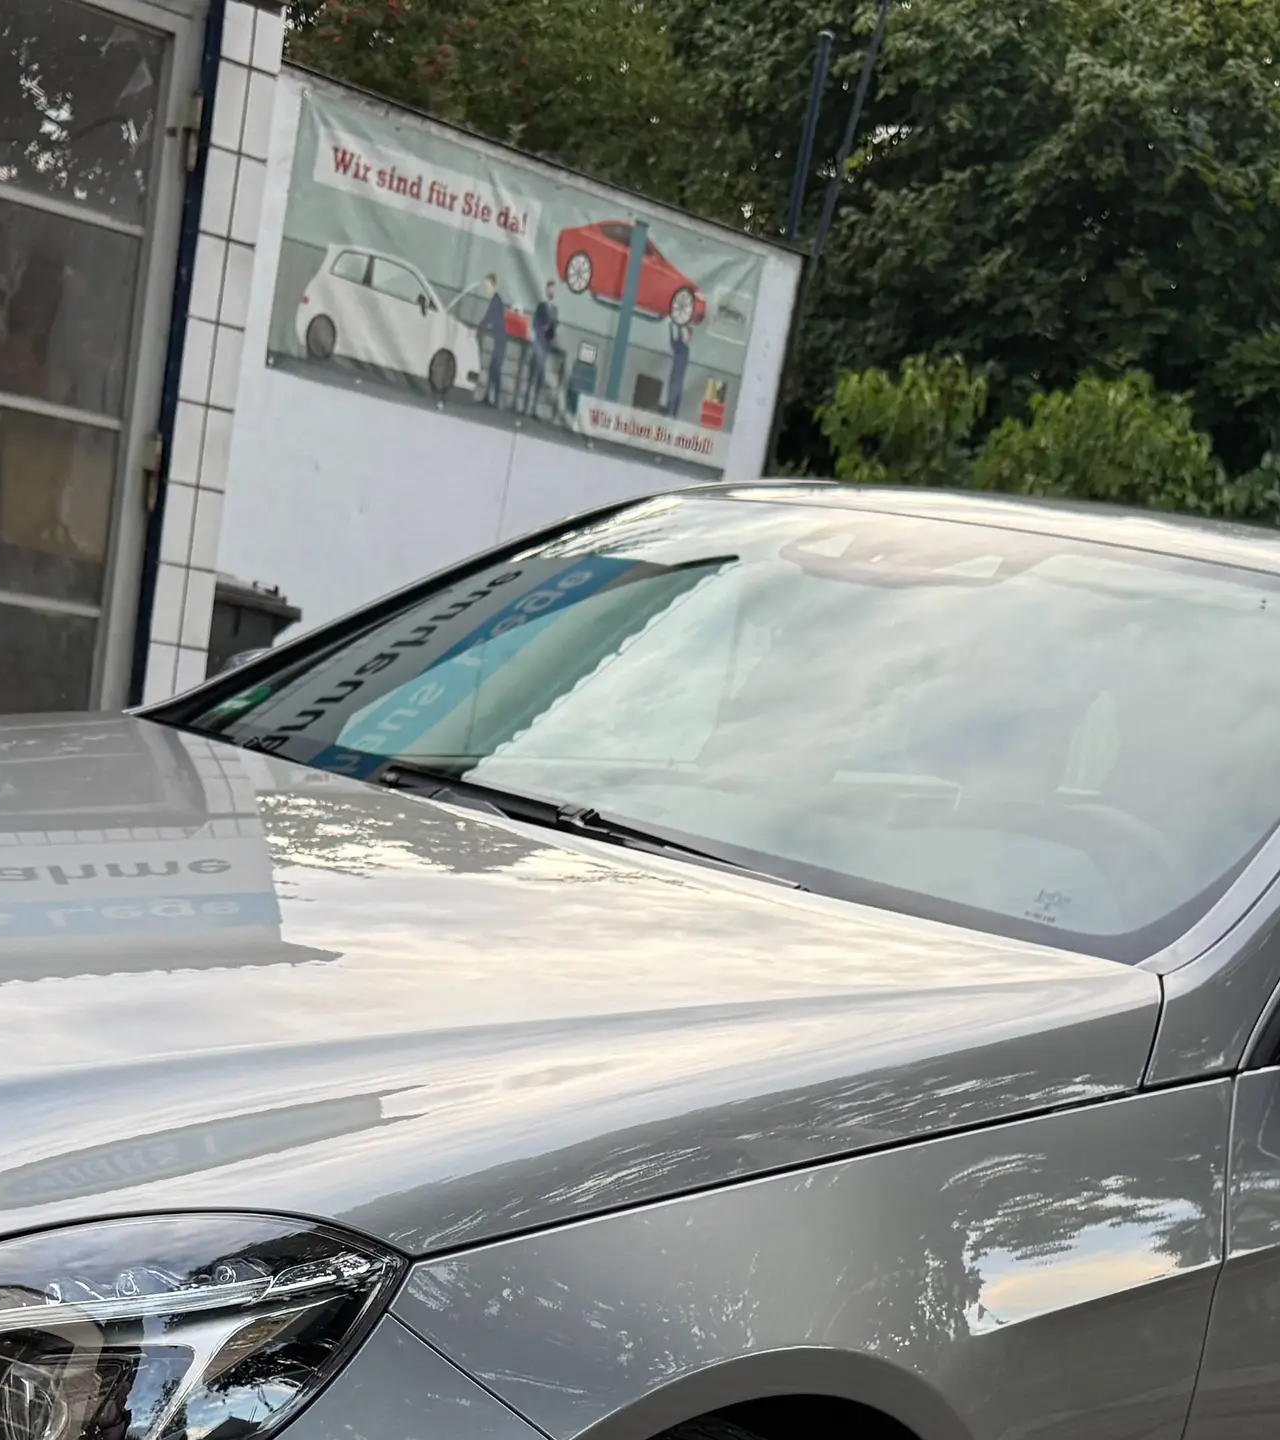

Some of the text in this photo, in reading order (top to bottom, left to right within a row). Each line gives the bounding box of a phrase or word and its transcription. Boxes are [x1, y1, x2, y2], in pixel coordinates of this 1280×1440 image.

[332, 145, 528, 235] Wir sind für Sie da!
[588, 407, 612, 429] Wir
